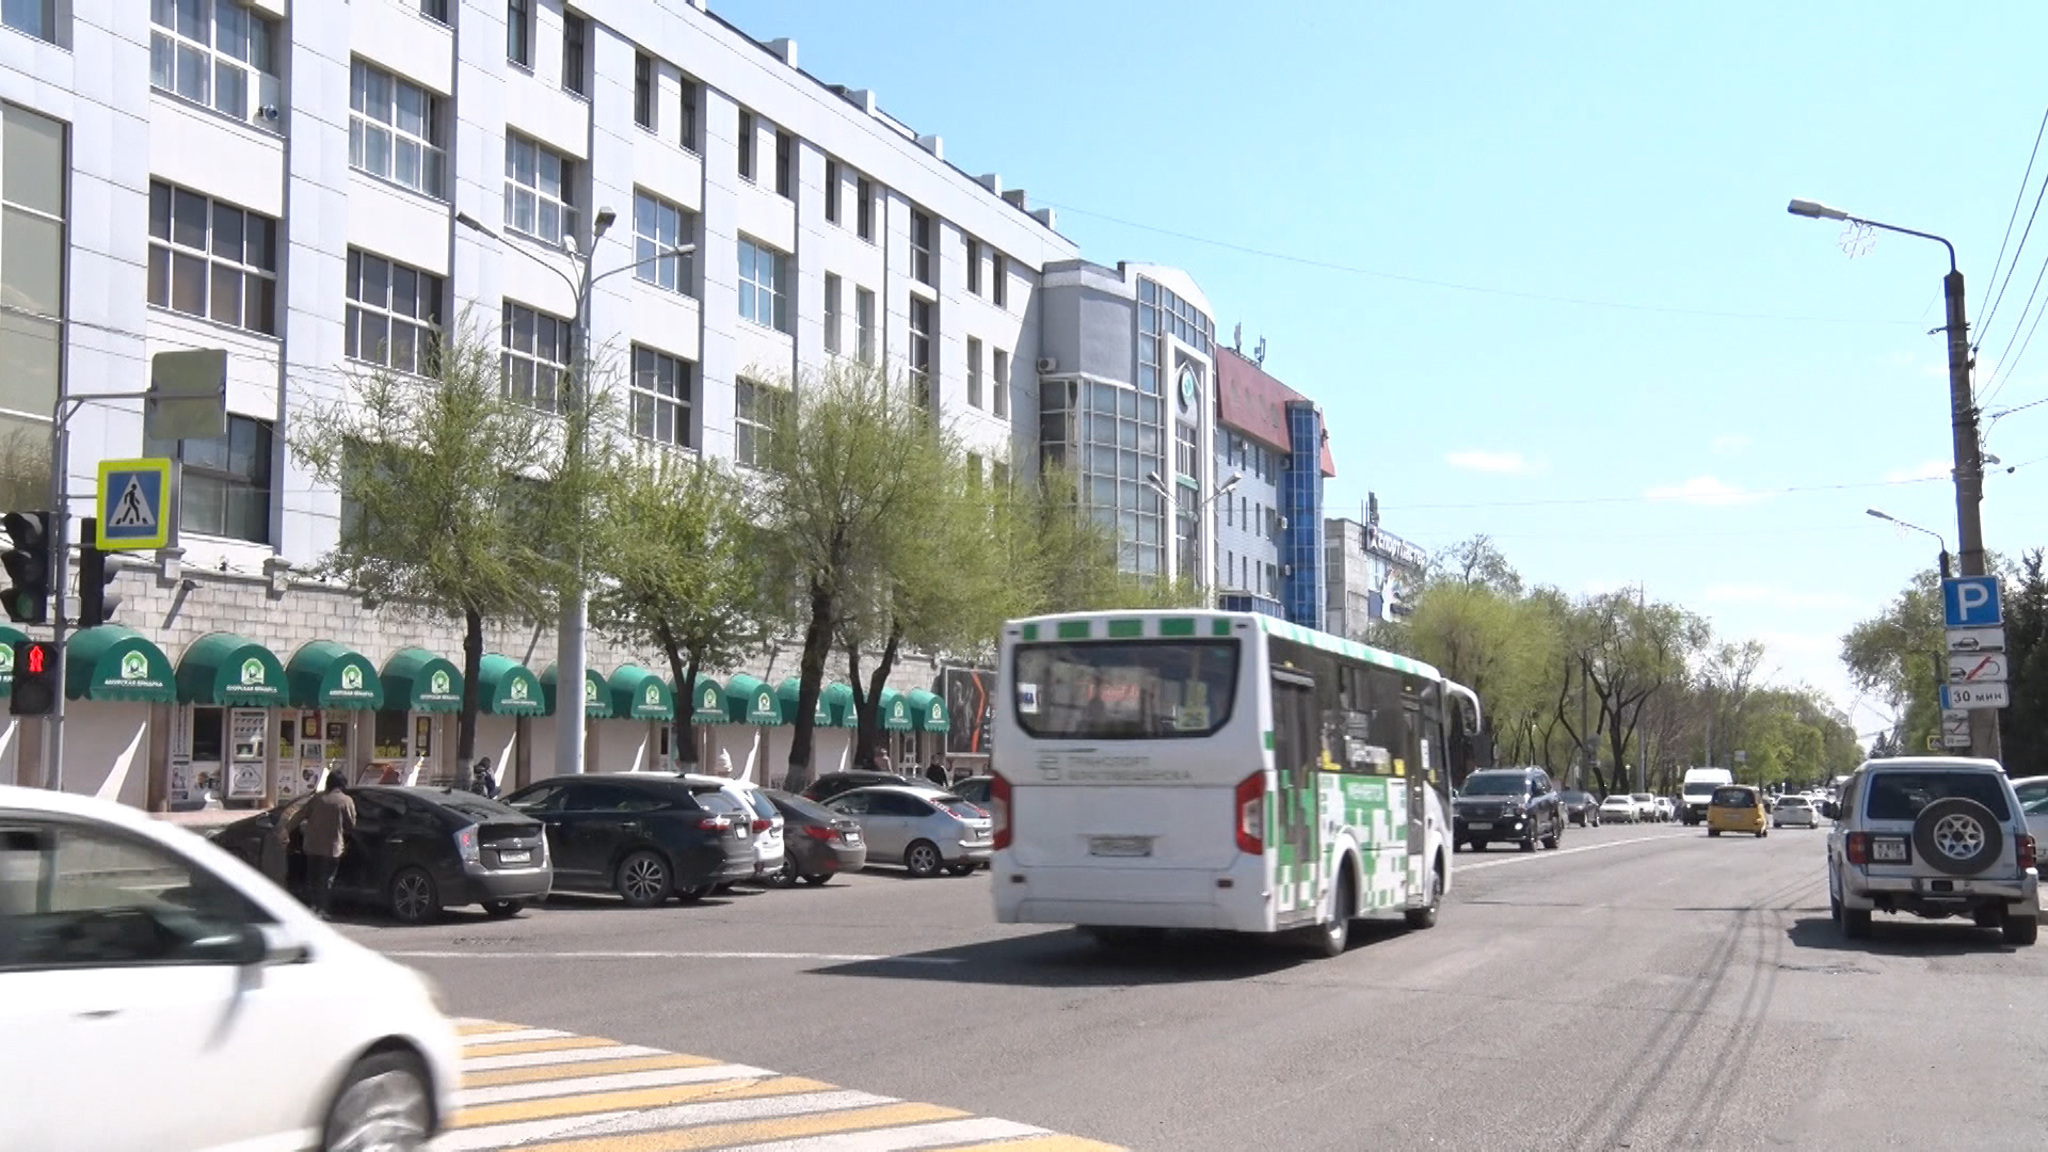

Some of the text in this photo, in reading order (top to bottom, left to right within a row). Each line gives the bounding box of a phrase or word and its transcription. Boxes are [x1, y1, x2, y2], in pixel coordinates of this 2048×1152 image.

[1958, 583, 1988, 620] P
[1953, 690, 2002, 703] 30 мин
